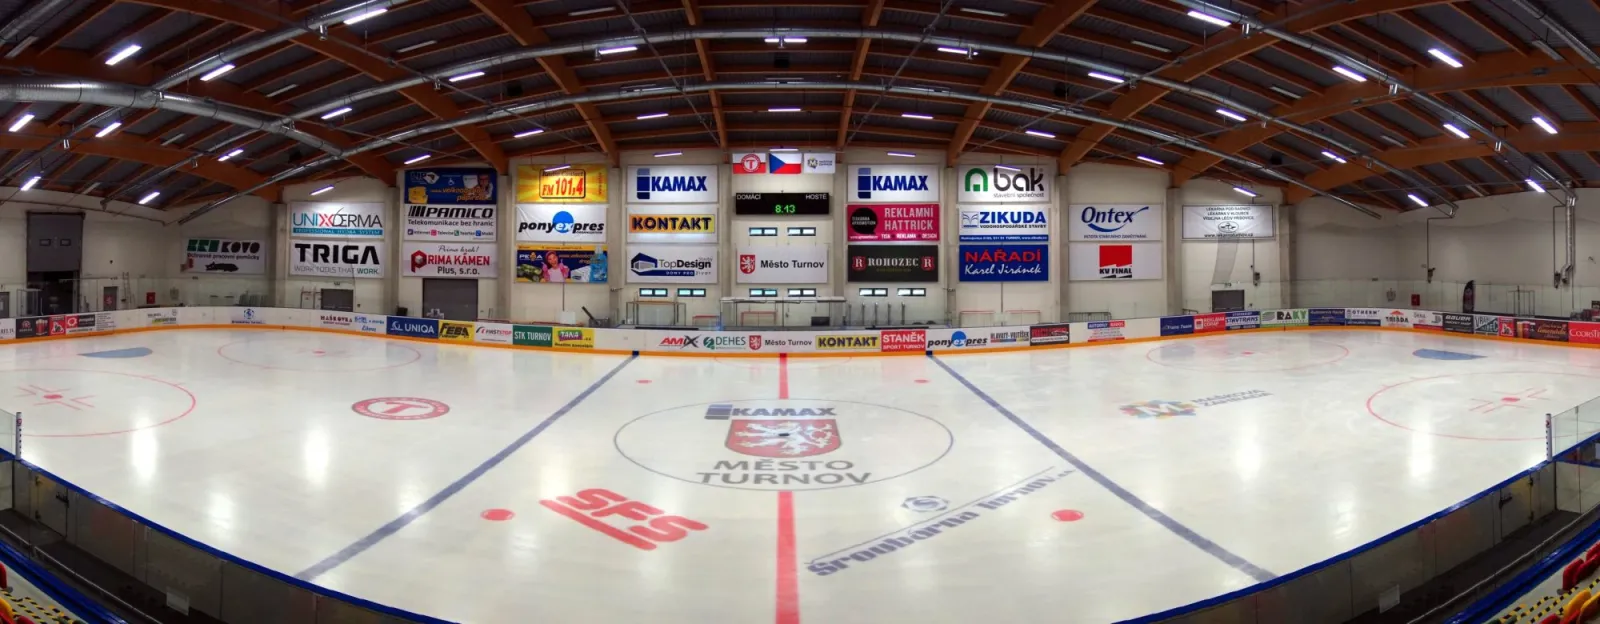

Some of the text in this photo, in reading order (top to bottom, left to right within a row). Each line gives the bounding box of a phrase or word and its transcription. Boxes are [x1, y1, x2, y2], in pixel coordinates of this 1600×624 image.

[542, 184, 554, 196] FM
[556, 177, 584, 196] 101,4
[652, 175, 708, 191] KAMAX
[872, 175, 929, 191] KAMAX
[426, 207, 494, 218] PAMICO
[884, 206, 934, 218] REKLAMNÍ
[979, 211, 1047, 224] ZIKUDA
[1081, 206, 1149, 224] Ontex
[408, 219, 459, 227] Telekomunikace
[460, 219, 472, 227] bez
[518, 221, 605, 235] ponyexpres
[631, 217, 713, 230] KONTAKT
[884, 219, 934, 231] HATTRICK
[221, 241, 261, 254] KOVO
[294, 243, 380, 265] TRIGA
[454, 252, 490, 266] KÁMEN
[965, 249, 1041, 263] NÁŘADÍ
[658, 259, 712, 270] TopDesign
[760, 259, 825, 269] Město Turnov
[867, 258, 919, 267] ROHOZEC
[294, 265, 315, 273] WORK
[315, 266, 337, 274] TOOLS
[437, 266, 481, 276] Plus, s.r.o.
[965, 263, 1042, 276] Karel Jiránek
[1276, 310, 1306, 321] RAKY
[404, 324, 435, 334] UNIQA
[514, 331, 526, 340] STK
[527, 331, 552, 341] TURNOV
[715, 337, 747, 346] DEHES
[765, 338, 812, 346] Město Turnov
[818, 337, 878, 347] KONTAKT
[882, 332, 925, 343] STANĚK
[731, 407, 838, 416] KAMAX
[712, 458, 855, 472] MĚSTO
[695, 472, 872, 485] TURNOV
[556, 488, 710, 543] SFS
